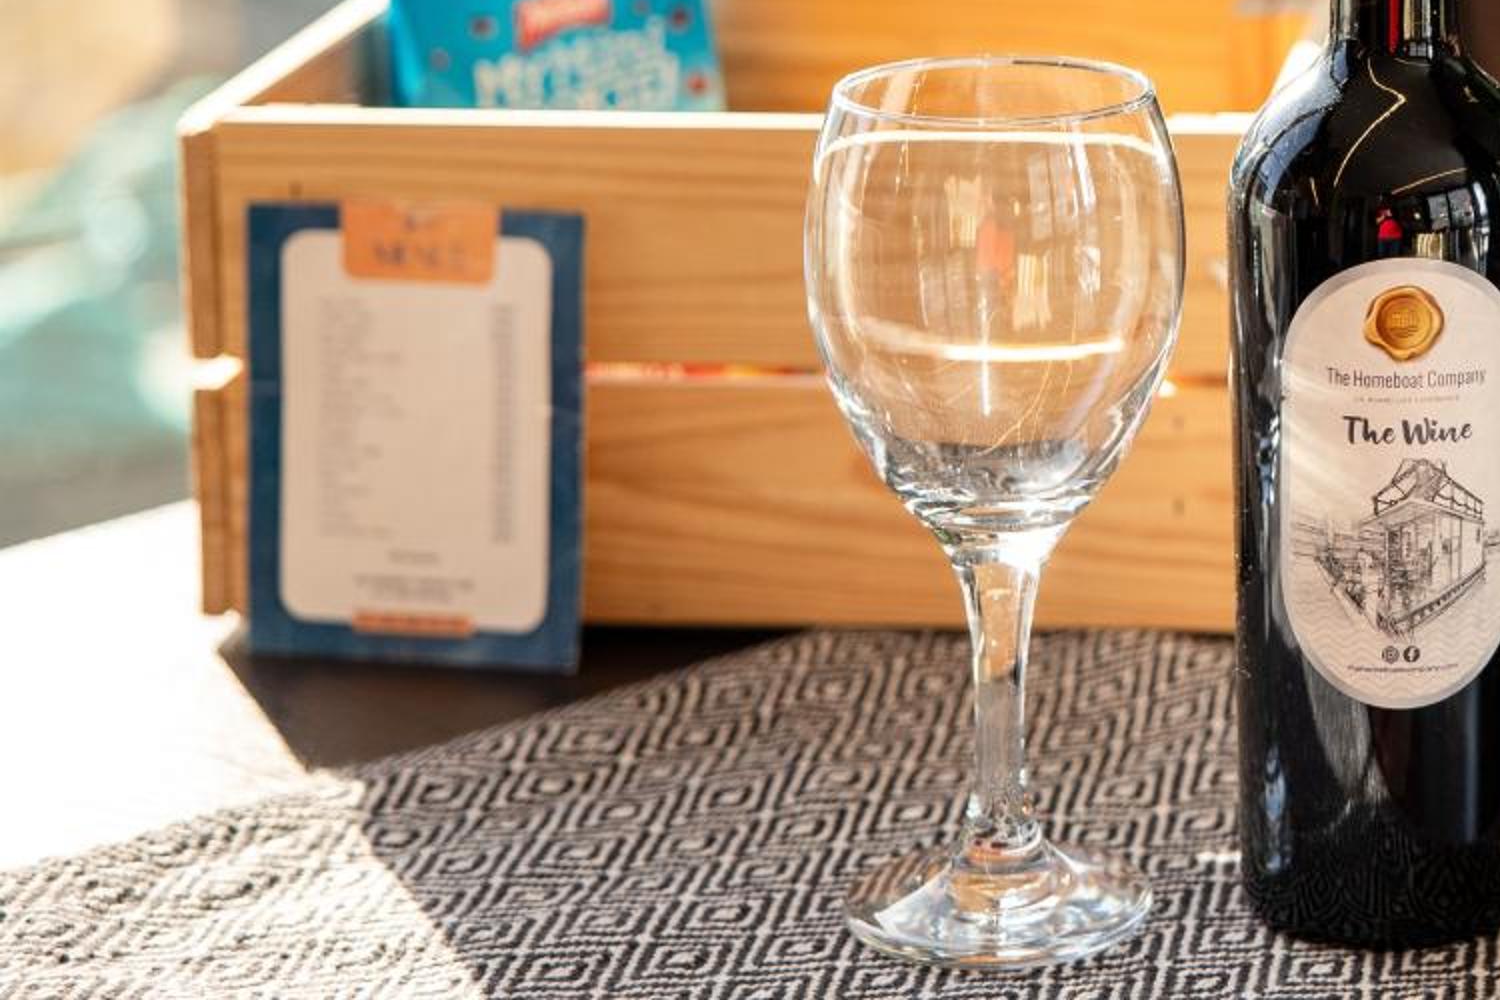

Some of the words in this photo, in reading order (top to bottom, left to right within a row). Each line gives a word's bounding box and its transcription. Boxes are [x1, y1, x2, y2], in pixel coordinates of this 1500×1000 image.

[1327, 367, 1350, 386] The
[1353, 370, 1424, 389] Homeboat
[1427, 369, 1486, 388] Company
[1342, 415, 1395, 445] The
[1401, 417, 1473, 445] Wine
